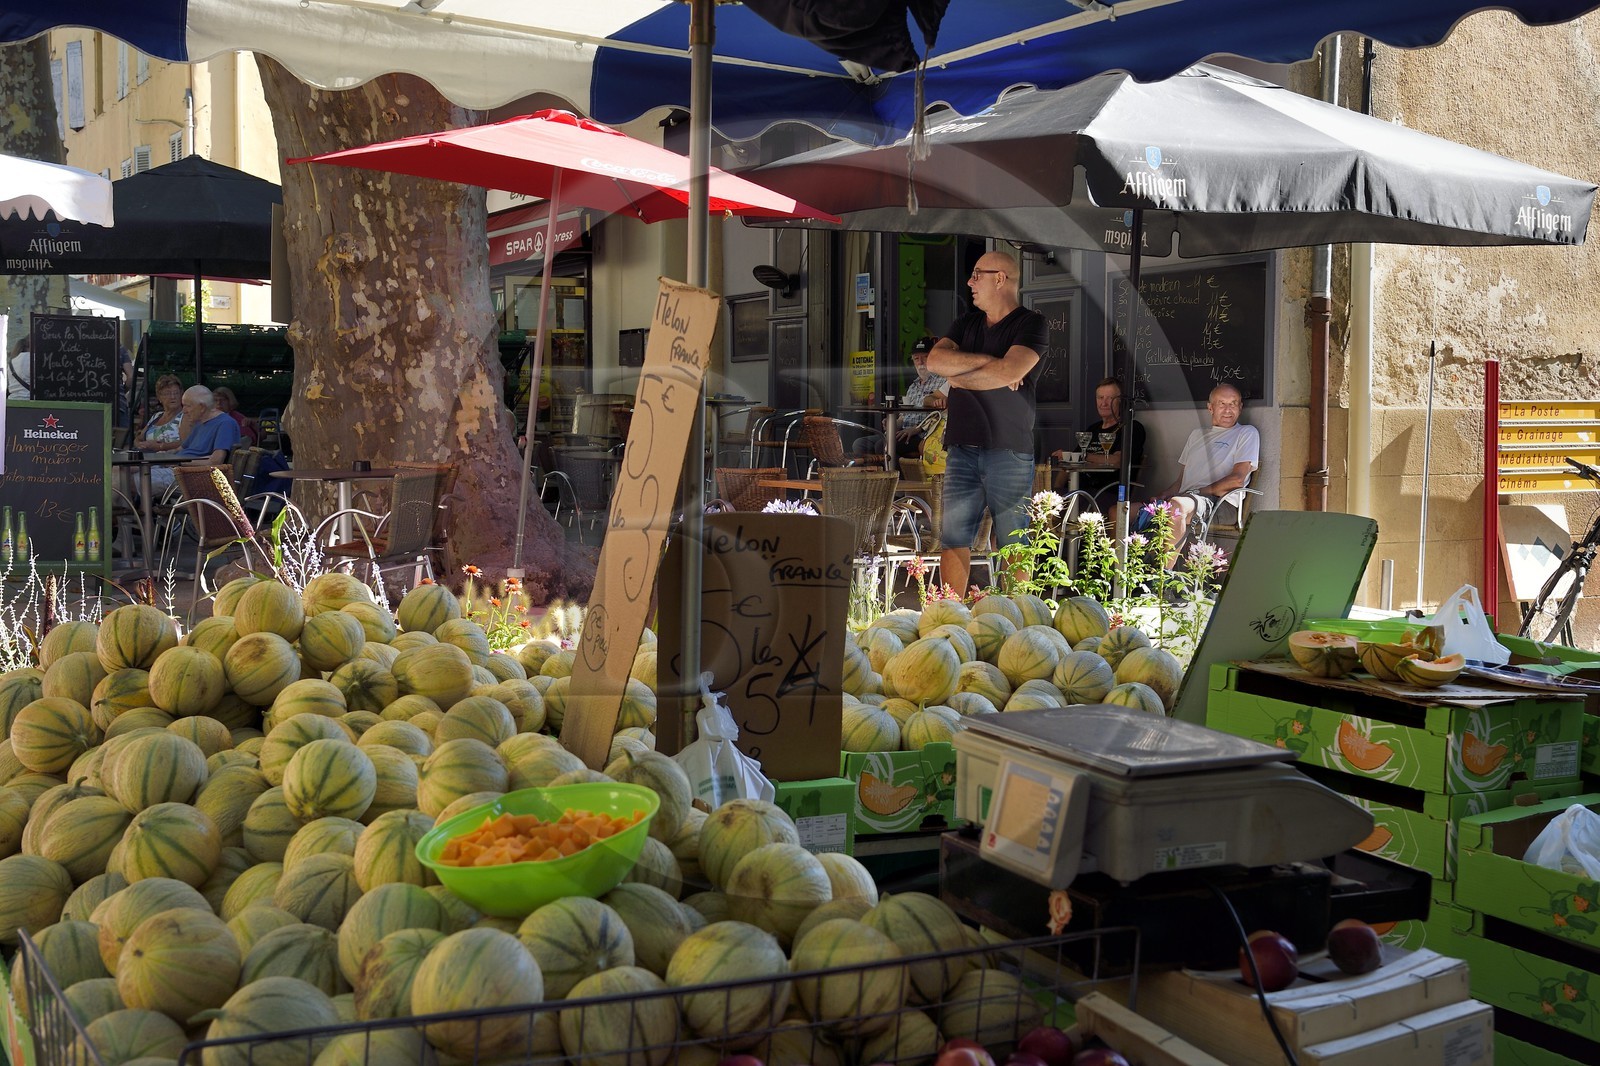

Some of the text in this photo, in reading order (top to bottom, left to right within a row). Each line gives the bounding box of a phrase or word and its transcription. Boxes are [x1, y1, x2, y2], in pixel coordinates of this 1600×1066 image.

[1119, 171, 1187, 200] Affligem
[1514, 205, 1572, 234] Affligem
[27, 238, 82, 256] Affligem
[506, 237, 533, 256] SPAR
[1514, 405, 1560, 417] La Poste
[23, 429, 78, 440] Heineken
[1500, 429, 1563, 442] Le Grainage
[1499, 453, 1567, 466] Médiathèque
[1499, 478, 1538, 489] Cinéma
